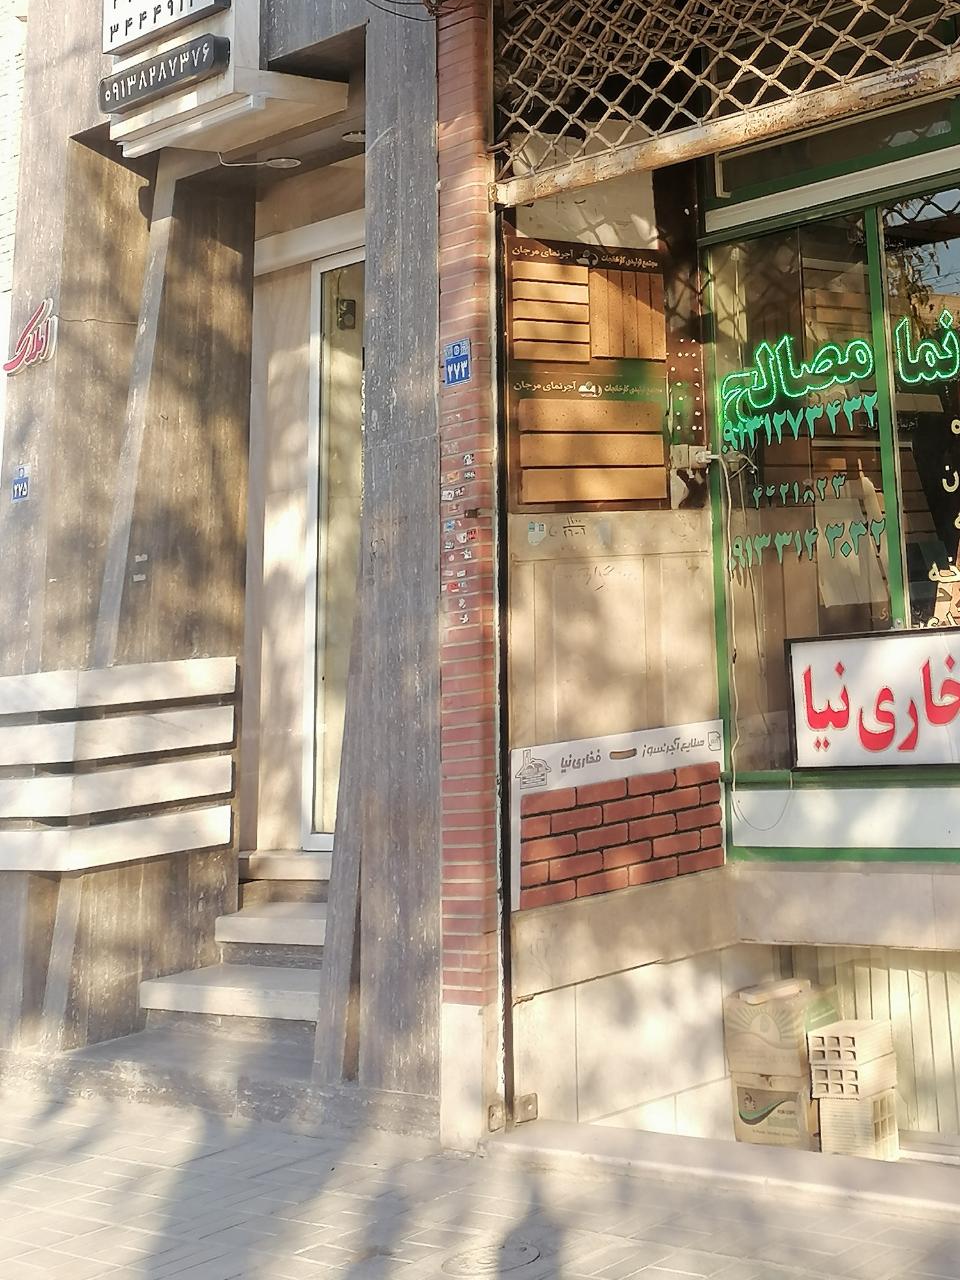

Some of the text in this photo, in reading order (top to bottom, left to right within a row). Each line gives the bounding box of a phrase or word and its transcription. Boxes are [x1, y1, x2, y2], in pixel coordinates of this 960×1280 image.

[105, 43, 210, 102] ۰۹۱۳۸۲۸۷۳۷۶
[721, 336, 876, 431] مصالح
[752, 473, 848, 510] ۴۴۲۱۸۲۳
[803, 661, 851, 752] نیا
